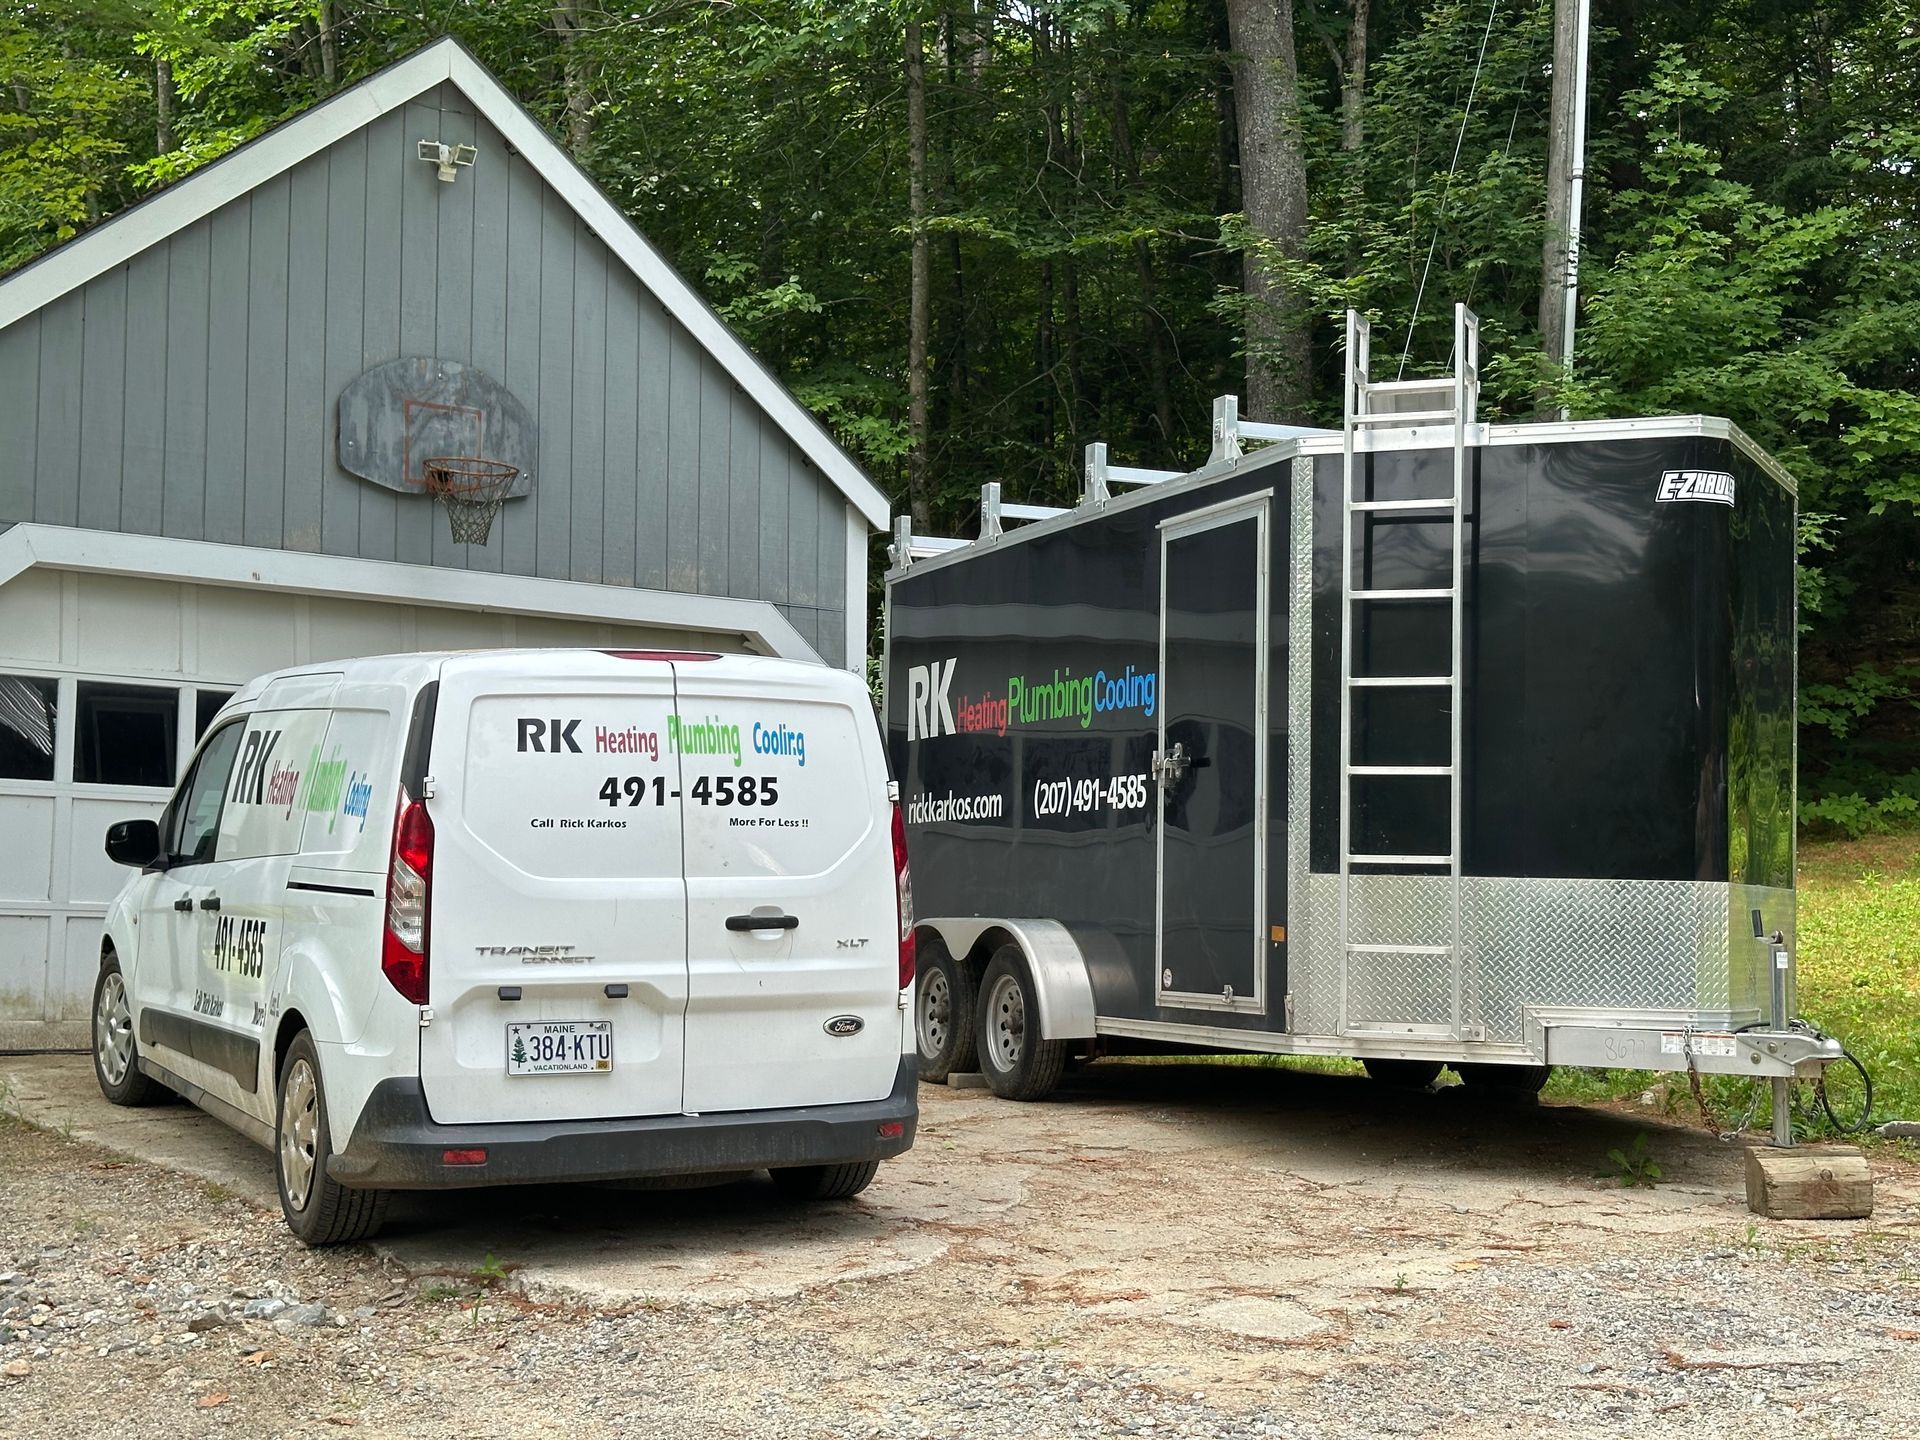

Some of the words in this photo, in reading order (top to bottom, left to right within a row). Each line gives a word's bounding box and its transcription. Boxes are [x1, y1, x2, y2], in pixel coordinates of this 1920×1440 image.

[907, 657, 957, 741] RK
[957, 692, 1007, 737] Heating
[1008, 667, 1093, 728] Plumbing
[1094, 664, 1155, 716] Cooling
[517, 718, 583, 753] RK
[595, 725, 658, 762] Heating
[667, 714, 742, 767] Plumbing
[232, 730, 282, 805] RK
[908, 790, 1002, 824] rickkarkos.com
[530, 818, 554, 828] Call
[560, 818, 584, 828] Rick
[587, 819, 627, 828] Karkos
[729, 817, 756, 827] More
[759, 817, 776, 827] For
[778, 817, 799, 827] Less
[214, 915, 267, 979] 491-4585
[836, 938, 869, 949] XLT
[475, 945, 575, 956] TRANSIT
[521, 956, 595, 964] CONNECT
[544, 1025, 575, 1034] MAINE
[834, 1020, 857, 1031] Ford
[534, 1063, 588, 1071] VACATIONLAND
